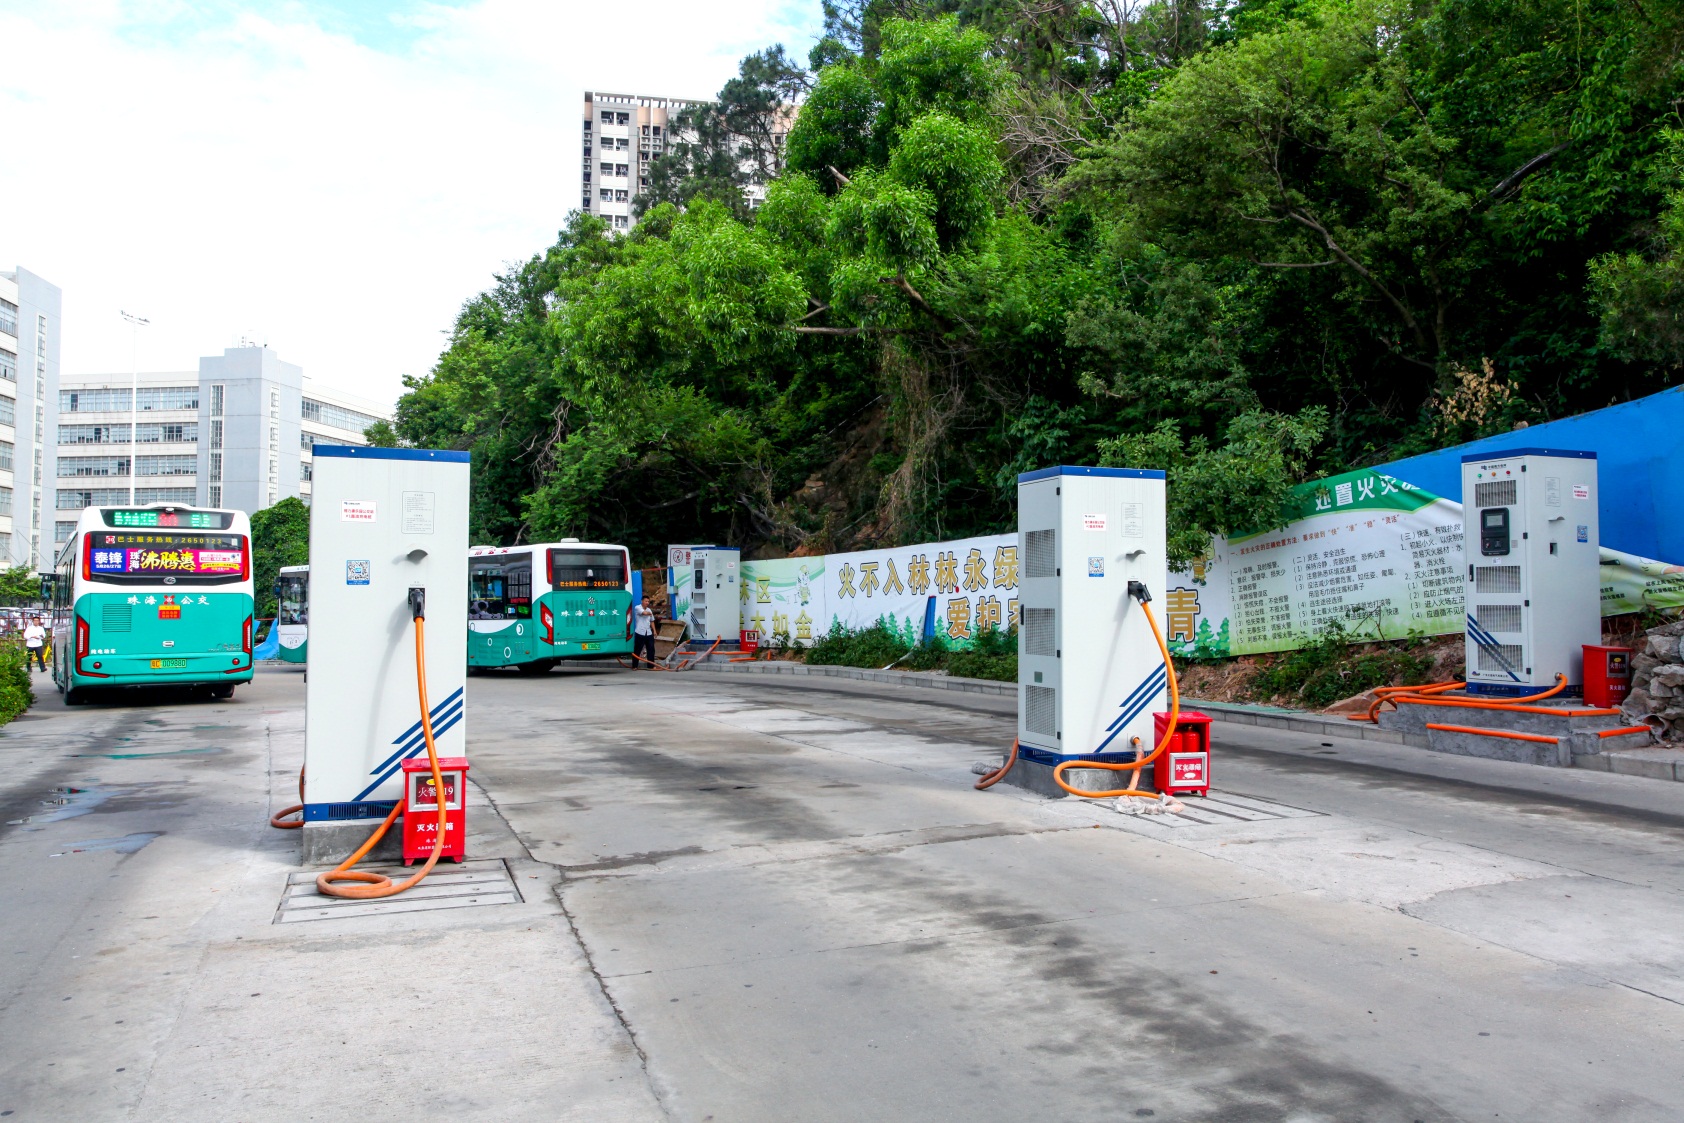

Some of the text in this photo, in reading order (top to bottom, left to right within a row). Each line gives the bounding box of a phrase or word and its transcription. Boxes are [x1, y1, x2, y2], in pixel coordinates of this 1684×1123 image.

[95, 552, 122, 563] 泰锋
[140, 551, 197, 570] 沸腾惠
[838, 546, 1018, 599] 火不入林林永绿
[417, 786, 454, 798] 火警19
[416, 822, 454, 833] 灭火箱
